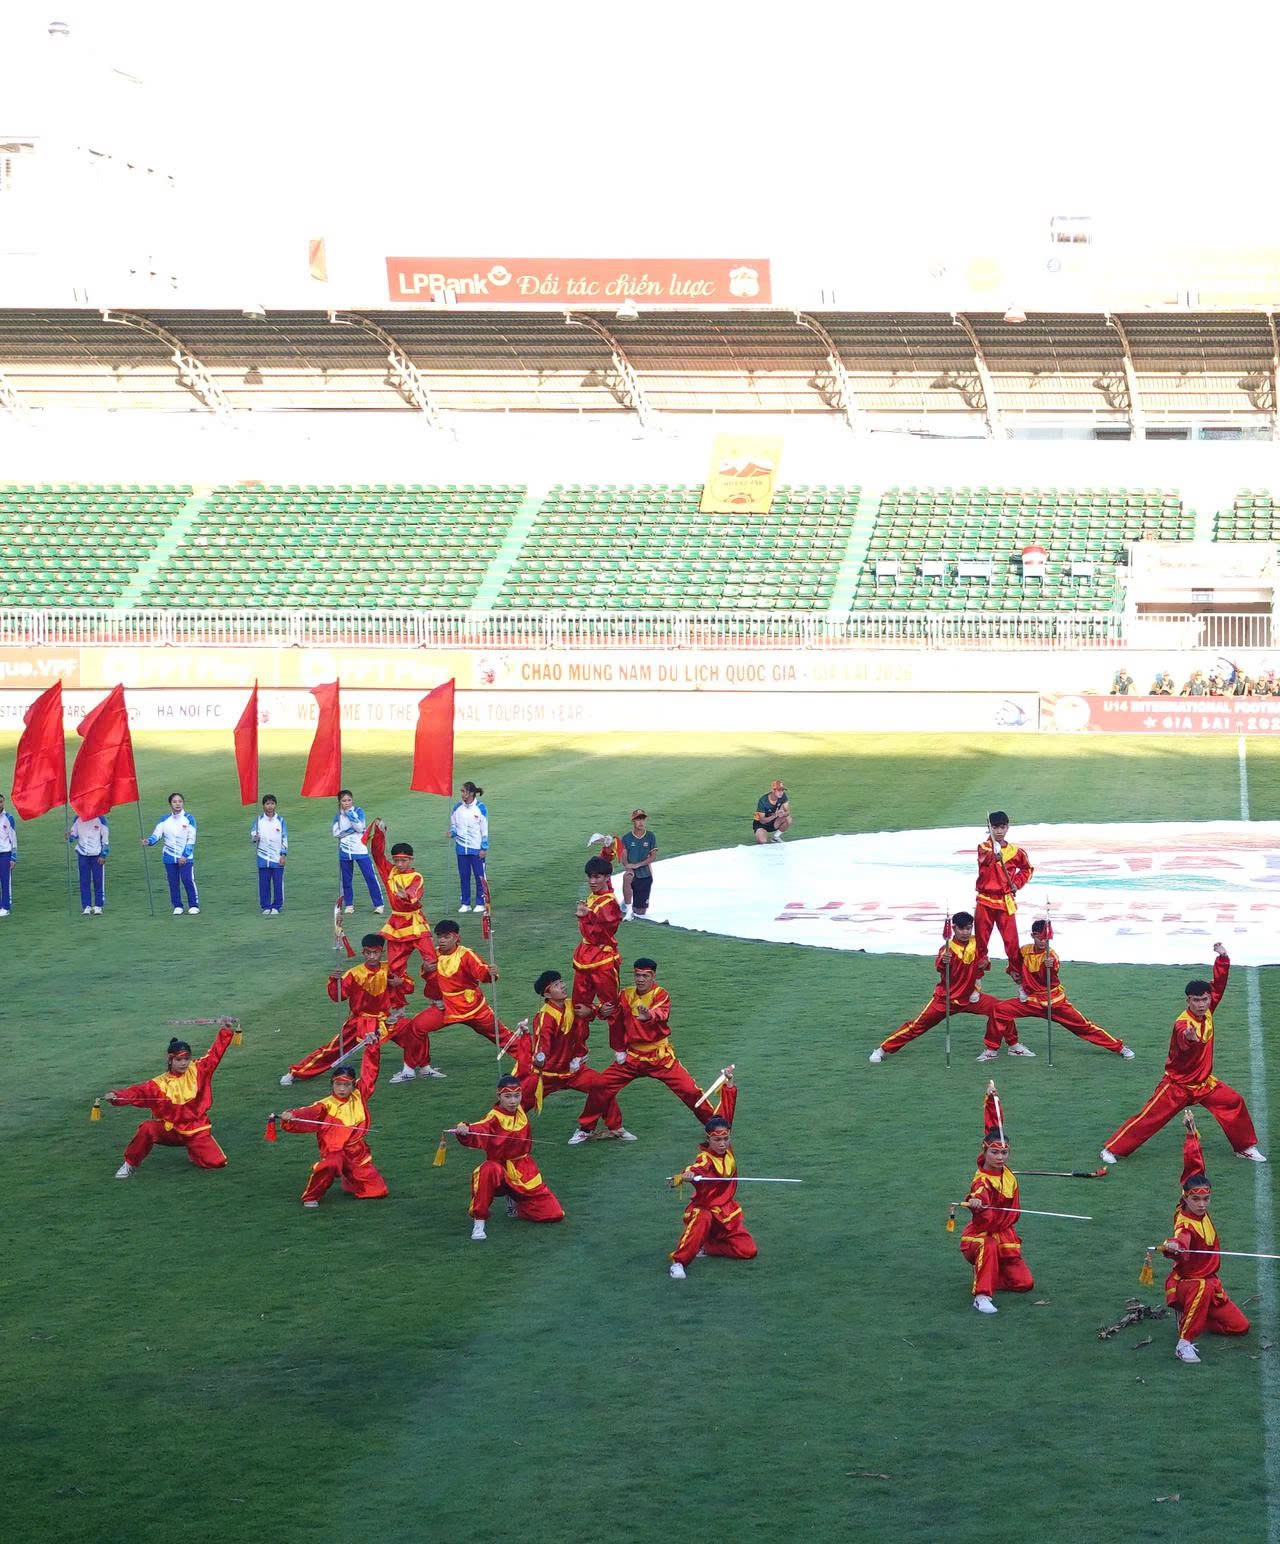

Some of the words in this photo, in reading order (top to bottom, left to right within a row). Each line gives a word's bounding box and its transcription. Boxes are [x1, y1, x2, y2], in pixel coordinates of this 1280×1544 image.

[399, 273, 488, 294] LPBank
[516, 272, 562, 296] Đối
[566, 276, 600, 296] tác
[604, 273, 664, 297] chiến
[668, 272, 716, 298] lược
[772, 663, 797, 682] GIA
[157, 704, 174, 718] HA
[179, 704, 200, 718] NOI
[206, 704, 222, 718] FC
[367, 703, 383, 721] TO
[389, 703, 414, 721] THE
[487, 703, 545, 722] TOURISM
[1103, 702, 1128, 713] U14
[1162, 716, 1193, 730] GIA
[1201, 716, 1231, 730] LAI
